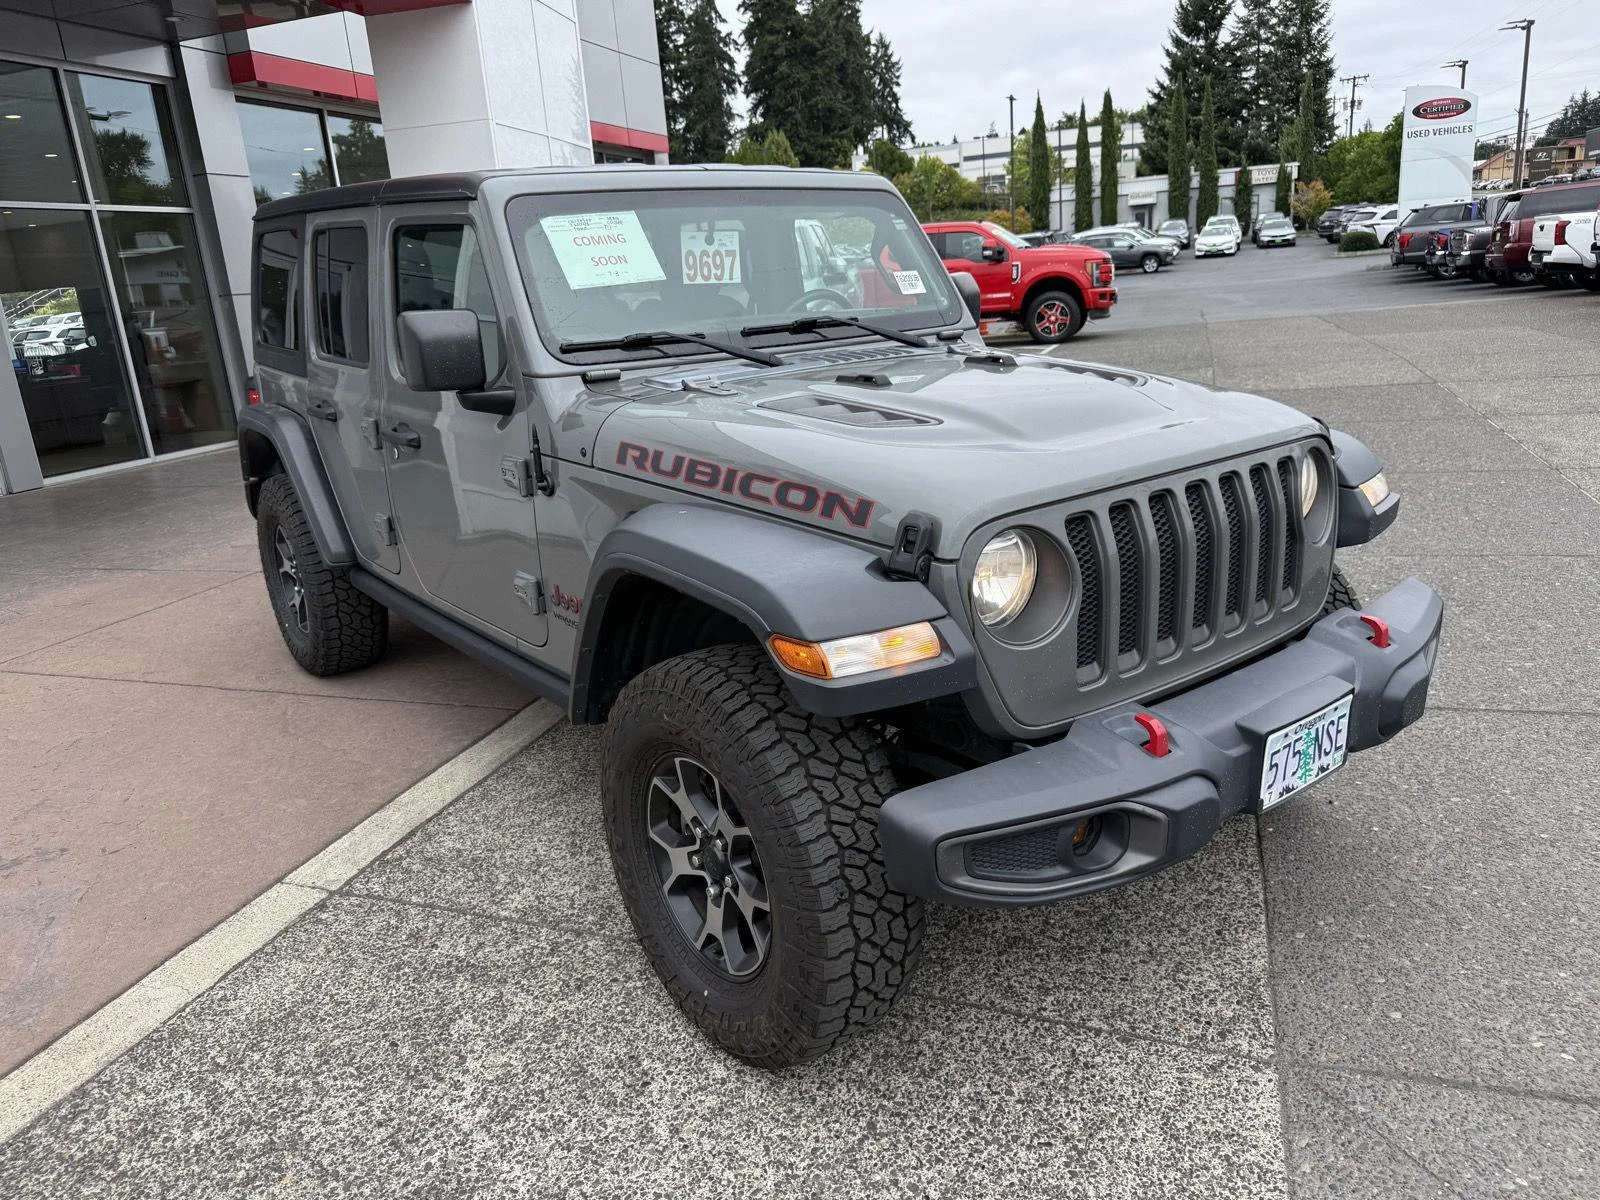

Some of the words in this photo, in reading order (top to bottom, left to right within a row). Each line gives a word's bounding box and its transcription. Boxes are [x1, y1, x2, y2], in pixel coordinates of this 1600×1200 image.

[1420, 103, 1465, 114] CERTIFIED
[1407, 129, 1430, 139] USED
[1432, 124, 1474, 137] VEHICLES
[572, 232, 627, 247] COMING
[590, 254, 629, 267] SOON
[684, 248, 737, 283] 9697
[615, 440, 876, 529] RUBICON
[1294, 712, 1327, 735] Oregon
[1265, 735, 1303, 790] 575
[1312, 712, 1347, 765] NSE
